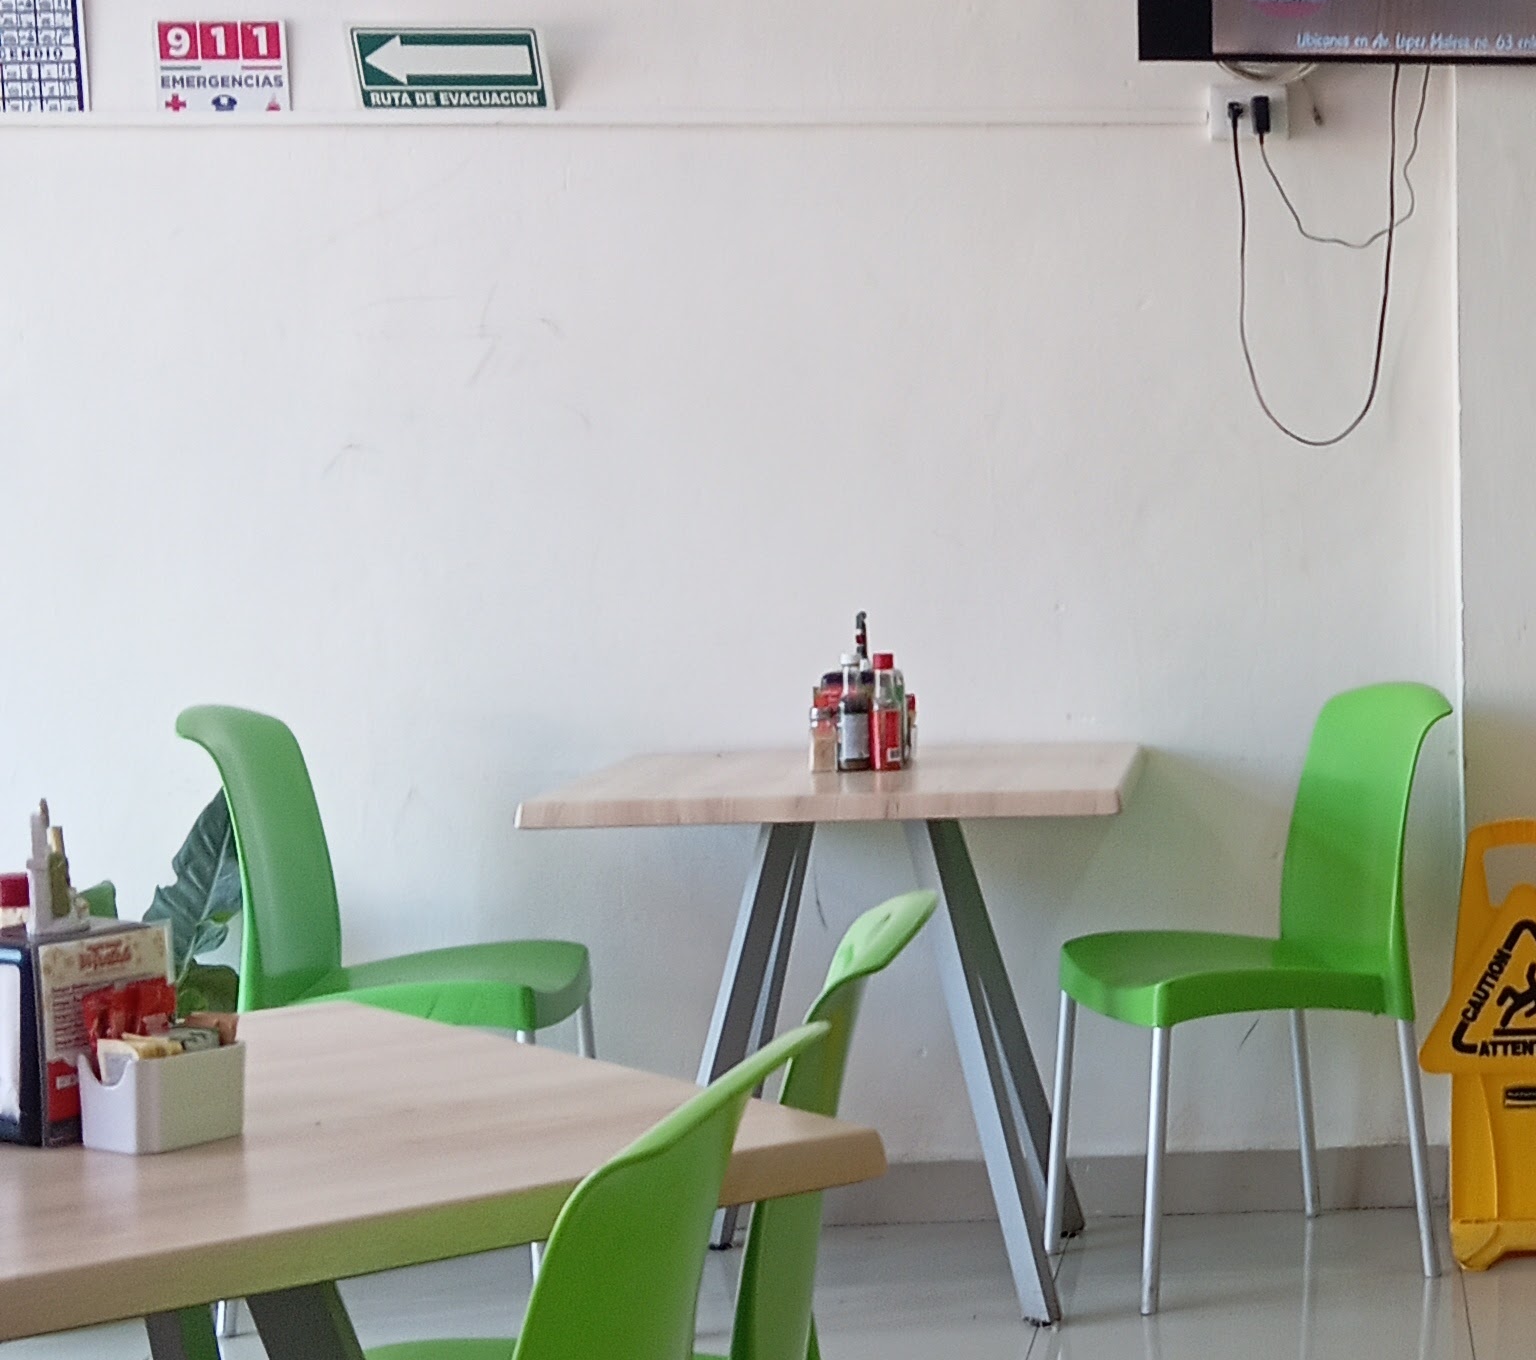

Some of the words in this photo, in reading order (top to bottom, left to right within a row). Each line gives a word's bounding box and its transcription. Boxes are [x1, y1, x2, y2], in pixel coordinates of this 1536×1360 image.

[166, 25, 269, 58] 911
[1495, 34, 1513, 50] 63
[160, 74, 284, 89] EMERGENCIAS
[370, 91, 413, 106] RUTA
[415, 91, 436, 106] DE
[1462, 948, 1512, 1022] CAUTION
